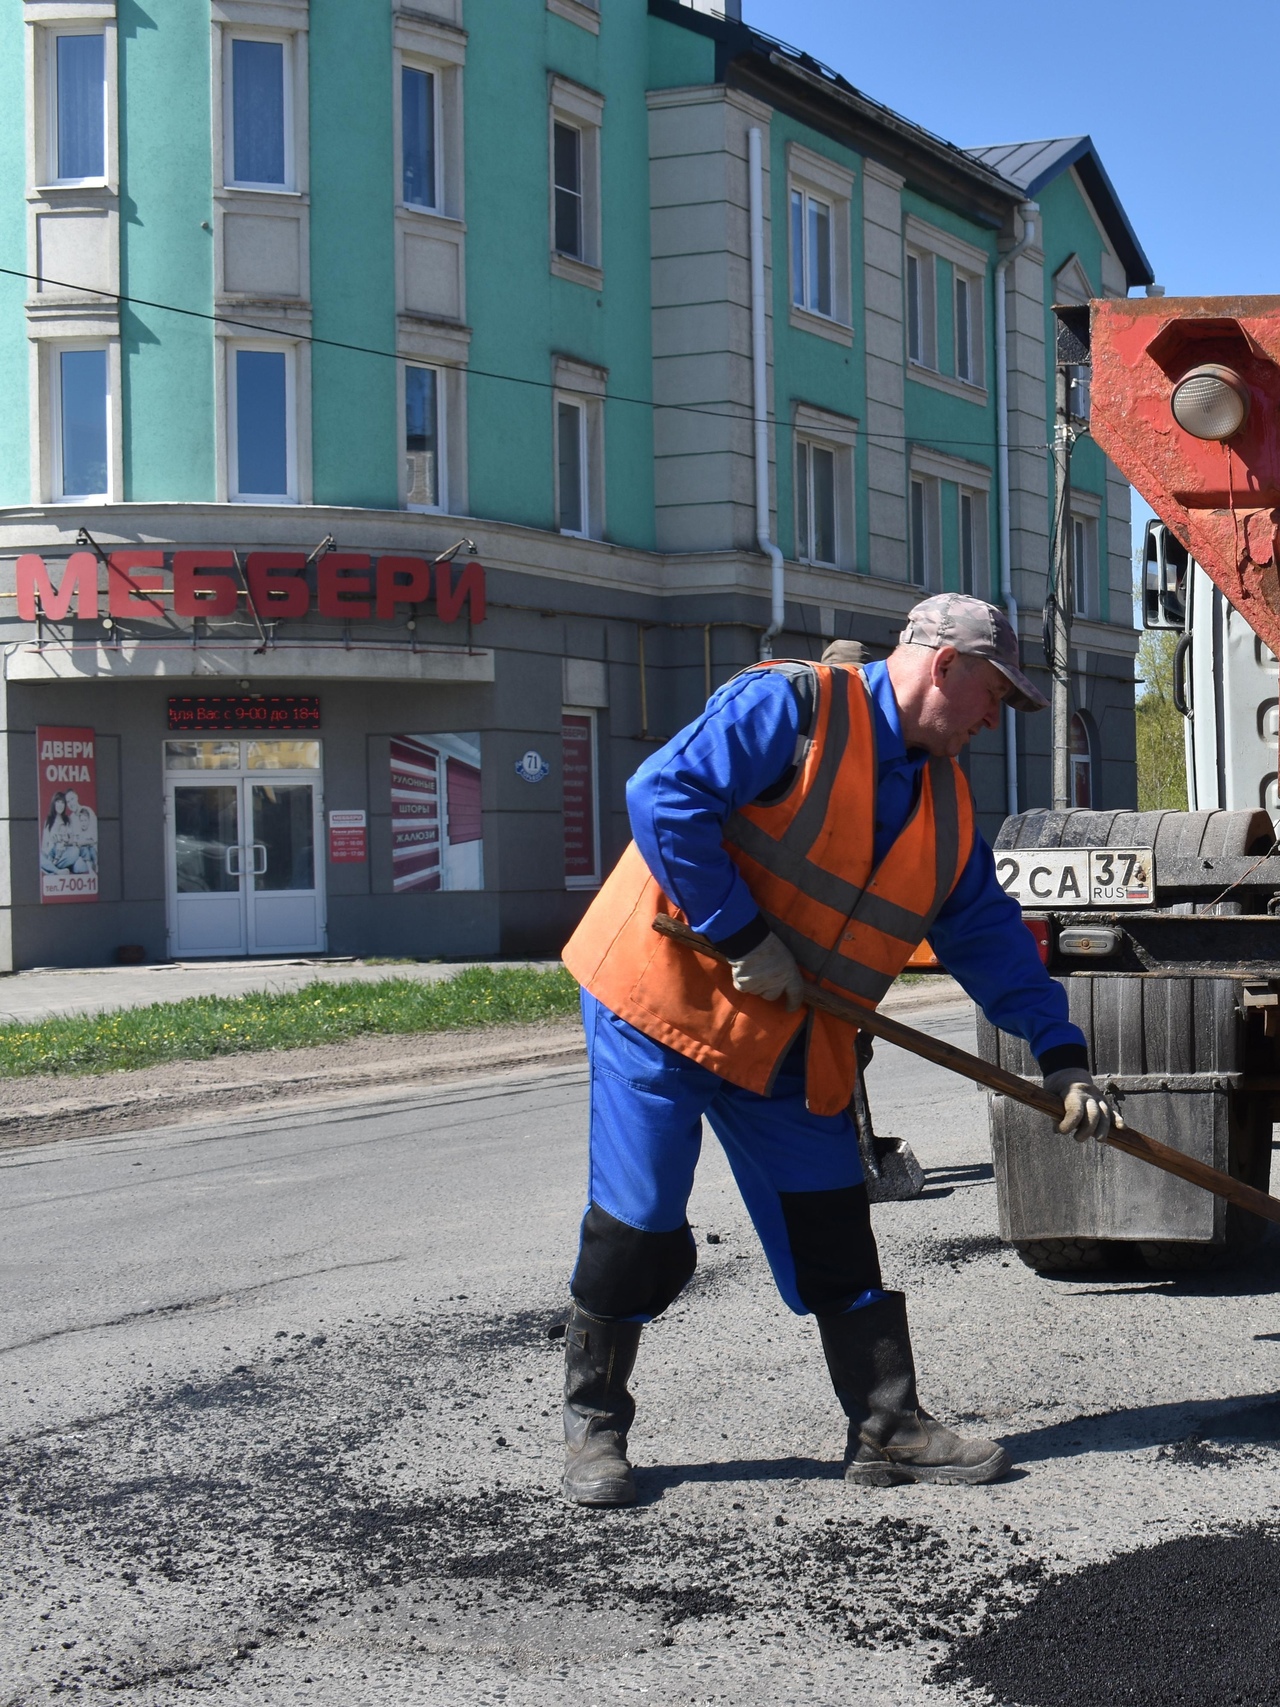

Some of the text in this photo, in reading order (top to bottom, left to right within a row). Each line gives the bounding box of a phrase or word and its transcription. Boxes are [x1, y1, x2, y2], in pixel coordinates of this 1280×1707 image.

[16, 550, 486, 625] МЕББЕРИ
[197, 707, 221, 719] Вас
[235, 707, 267, 719] 9-00
[271, 710, 288, 722] до
[41, 740, 94, 761] ДВЕРИ
[527, 755, 538, 769] 71
[46, 765, 91, 783] ОКНА
[393, 775, 436, 790] РУЛОННЫЕ
[399, 804, 430, 814] ШТОРЫ
[396, 830, 436, 843] ЖАЛЮЗИ
[1095, 853, 1138, 886] 37
[59, 878, 96, 892] 7-00-11
[1093, 887, 1125, 899] RUS
